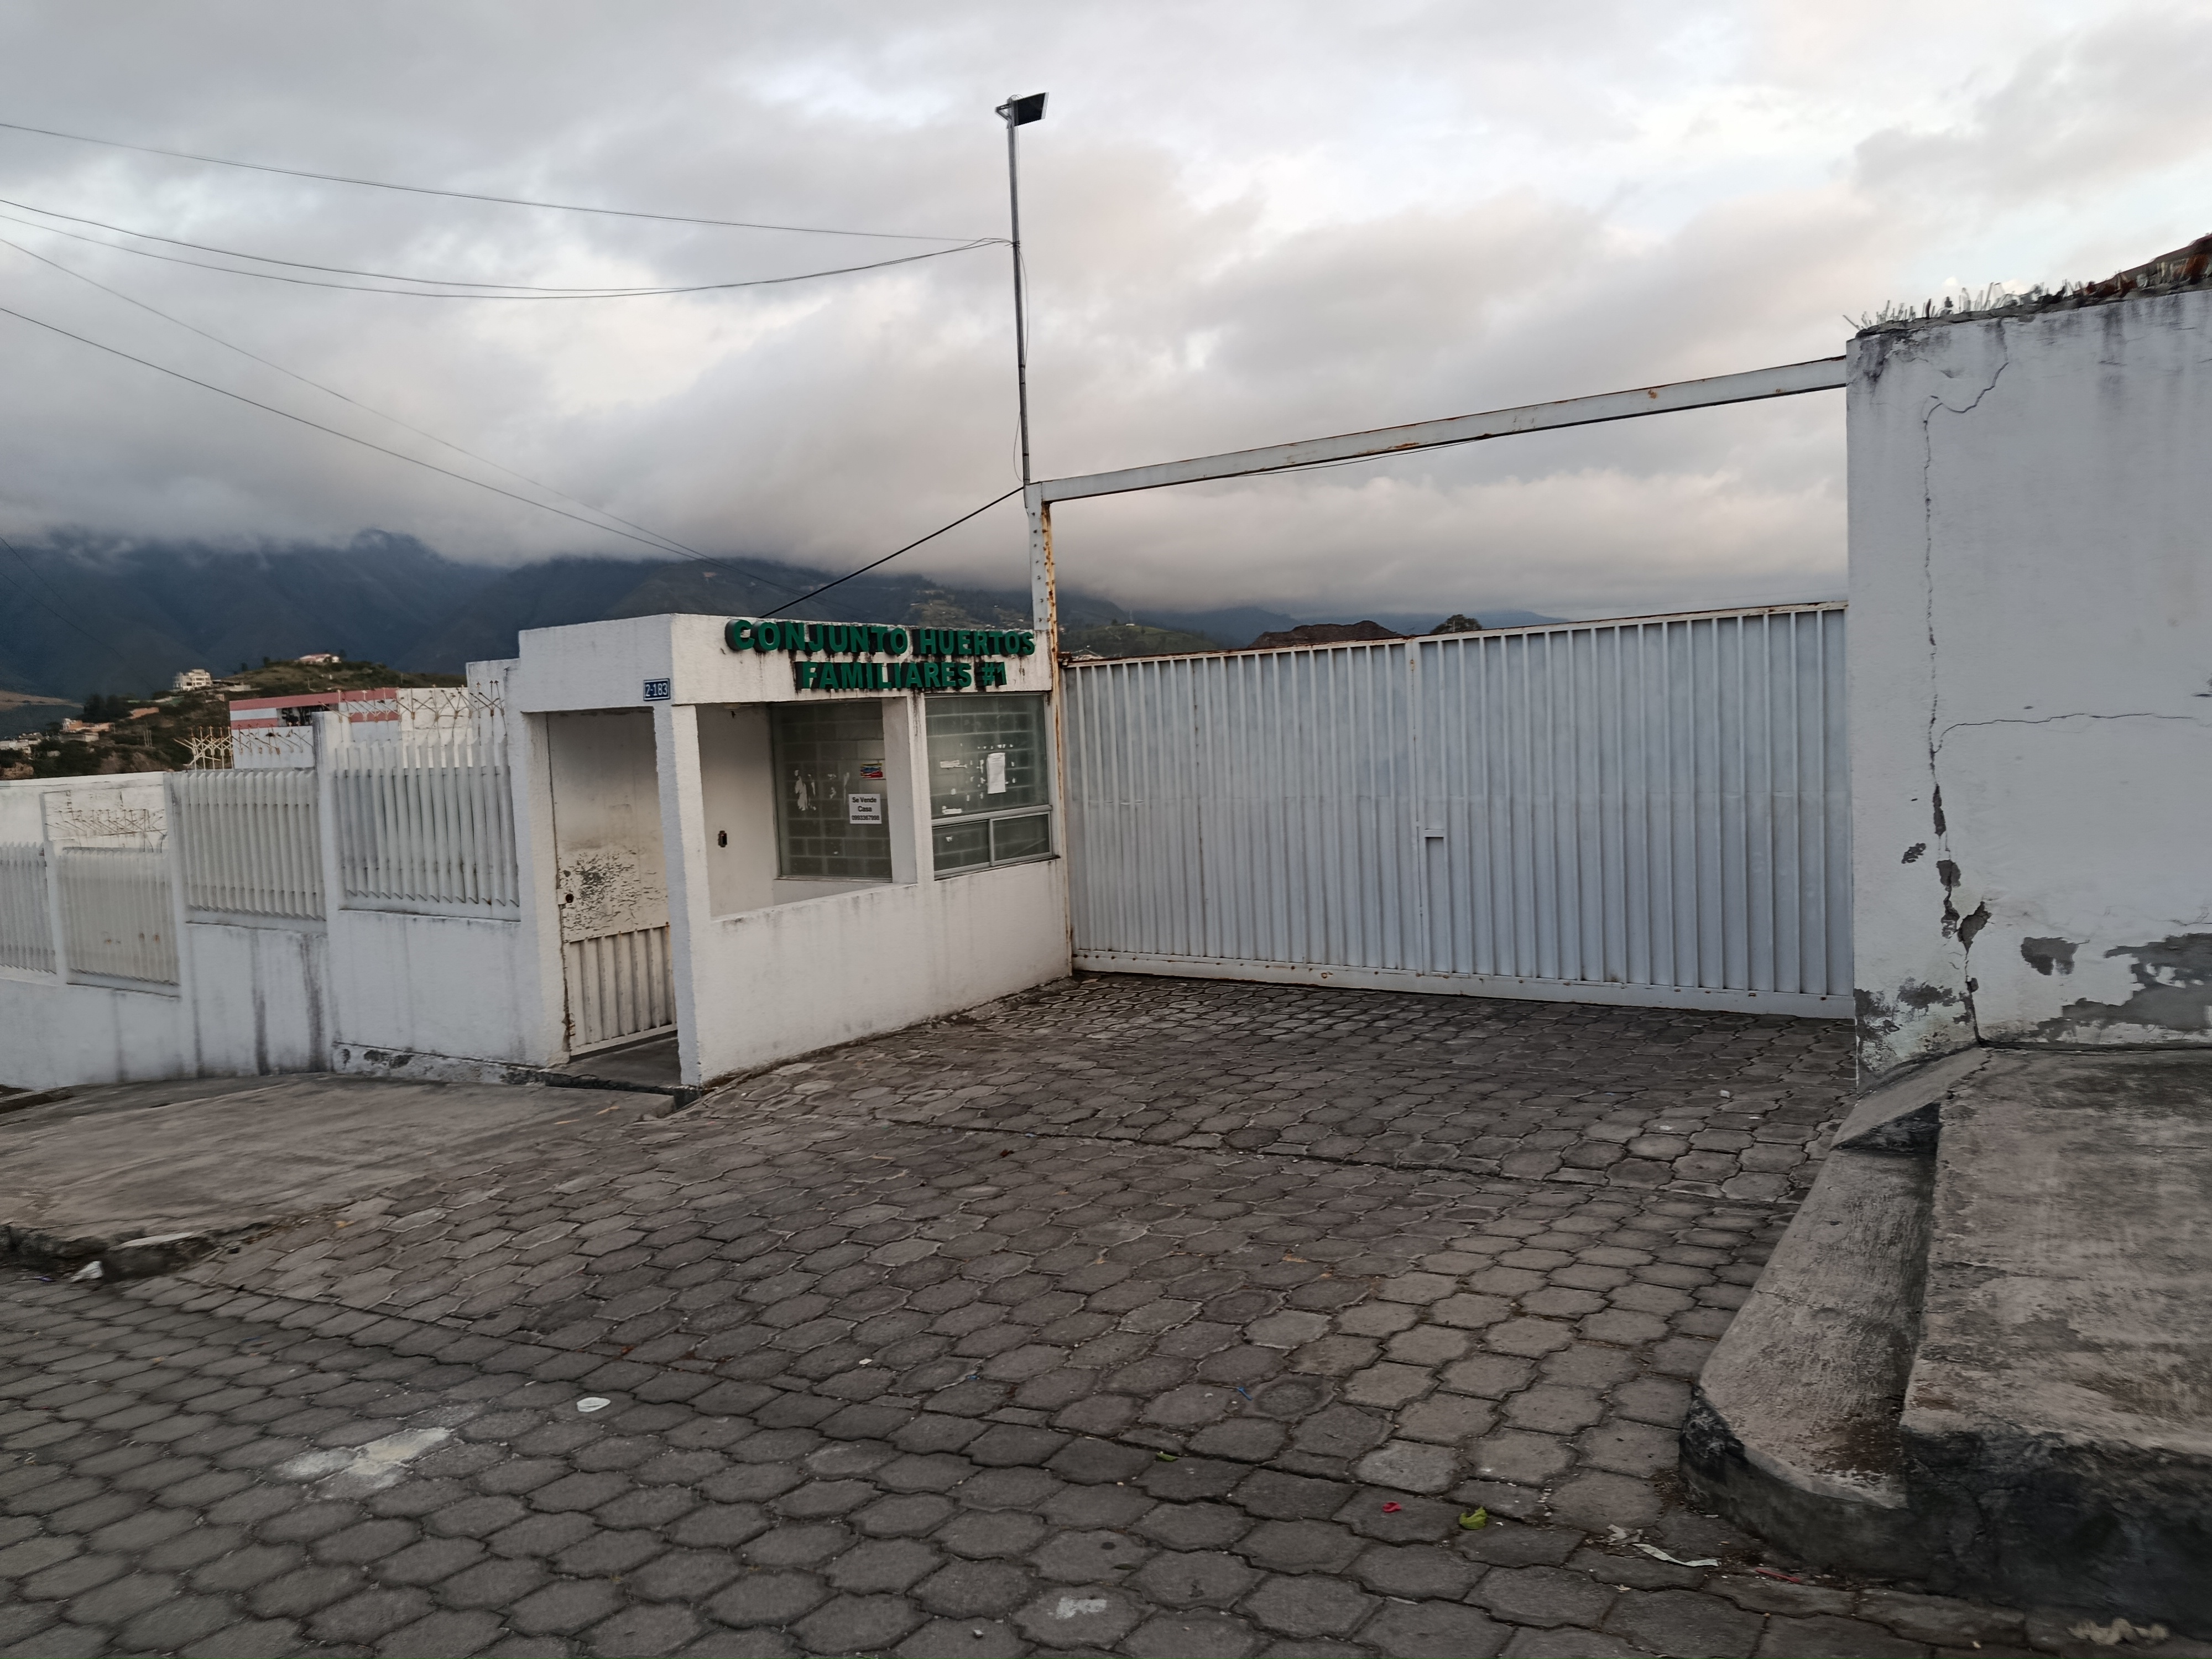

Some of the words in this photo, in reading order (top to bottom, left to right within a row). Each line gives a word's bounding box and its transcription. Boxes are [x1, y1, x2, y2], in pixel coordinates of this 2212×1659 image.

[725, 619, 908, 655] CONJUNTO
[915, 628, 1035, 655] HUERTOS
[797, 661, 972, 689] FAMILIARES
[979, 661, 1007, 686] #1
[645, 682, 667, 697] 2-183
